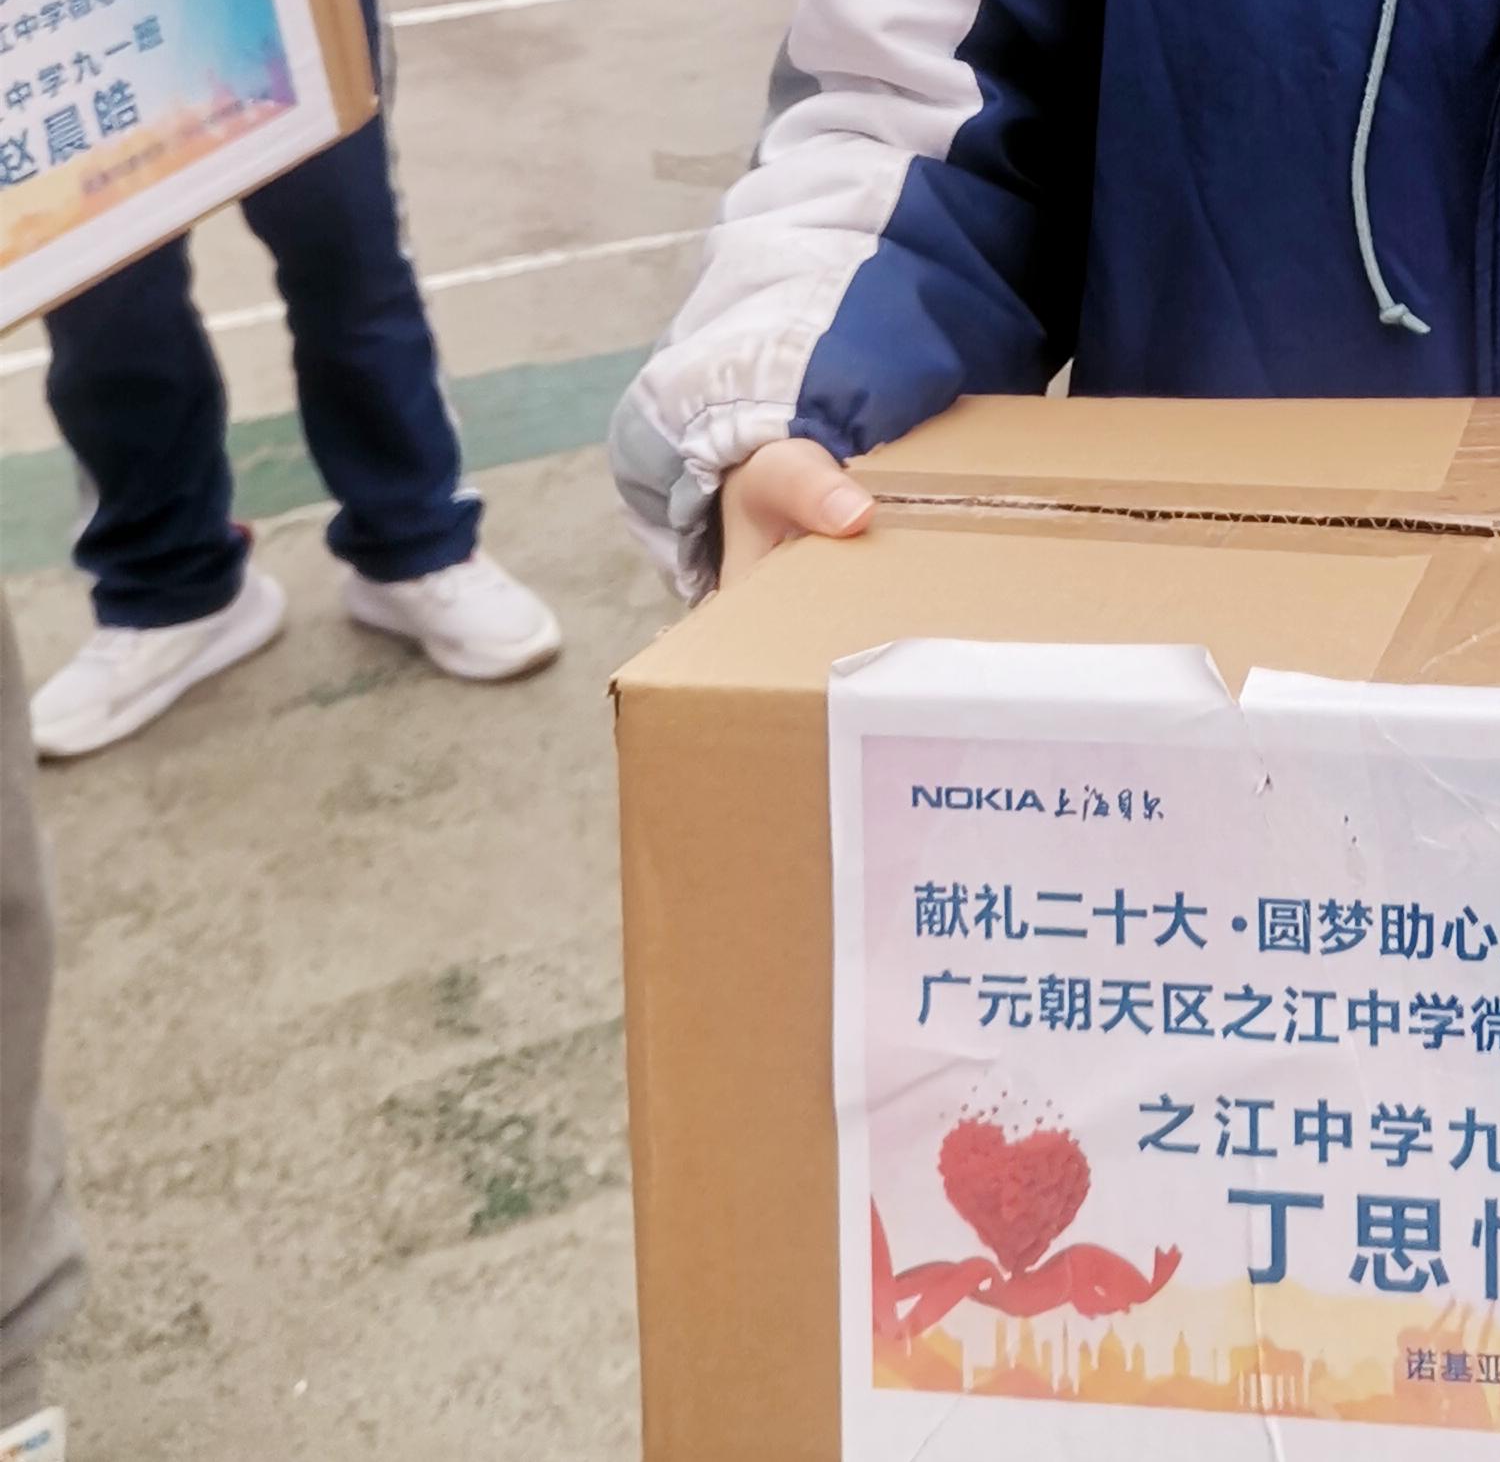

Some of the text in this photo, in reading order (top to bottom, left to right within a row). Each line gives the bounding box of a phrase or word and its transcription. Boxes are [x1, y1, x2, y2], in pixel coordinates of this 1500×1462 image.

[912, 785, 1046, 812] NOKIA
[914, 880, 1208, 950] 献礼二十大
